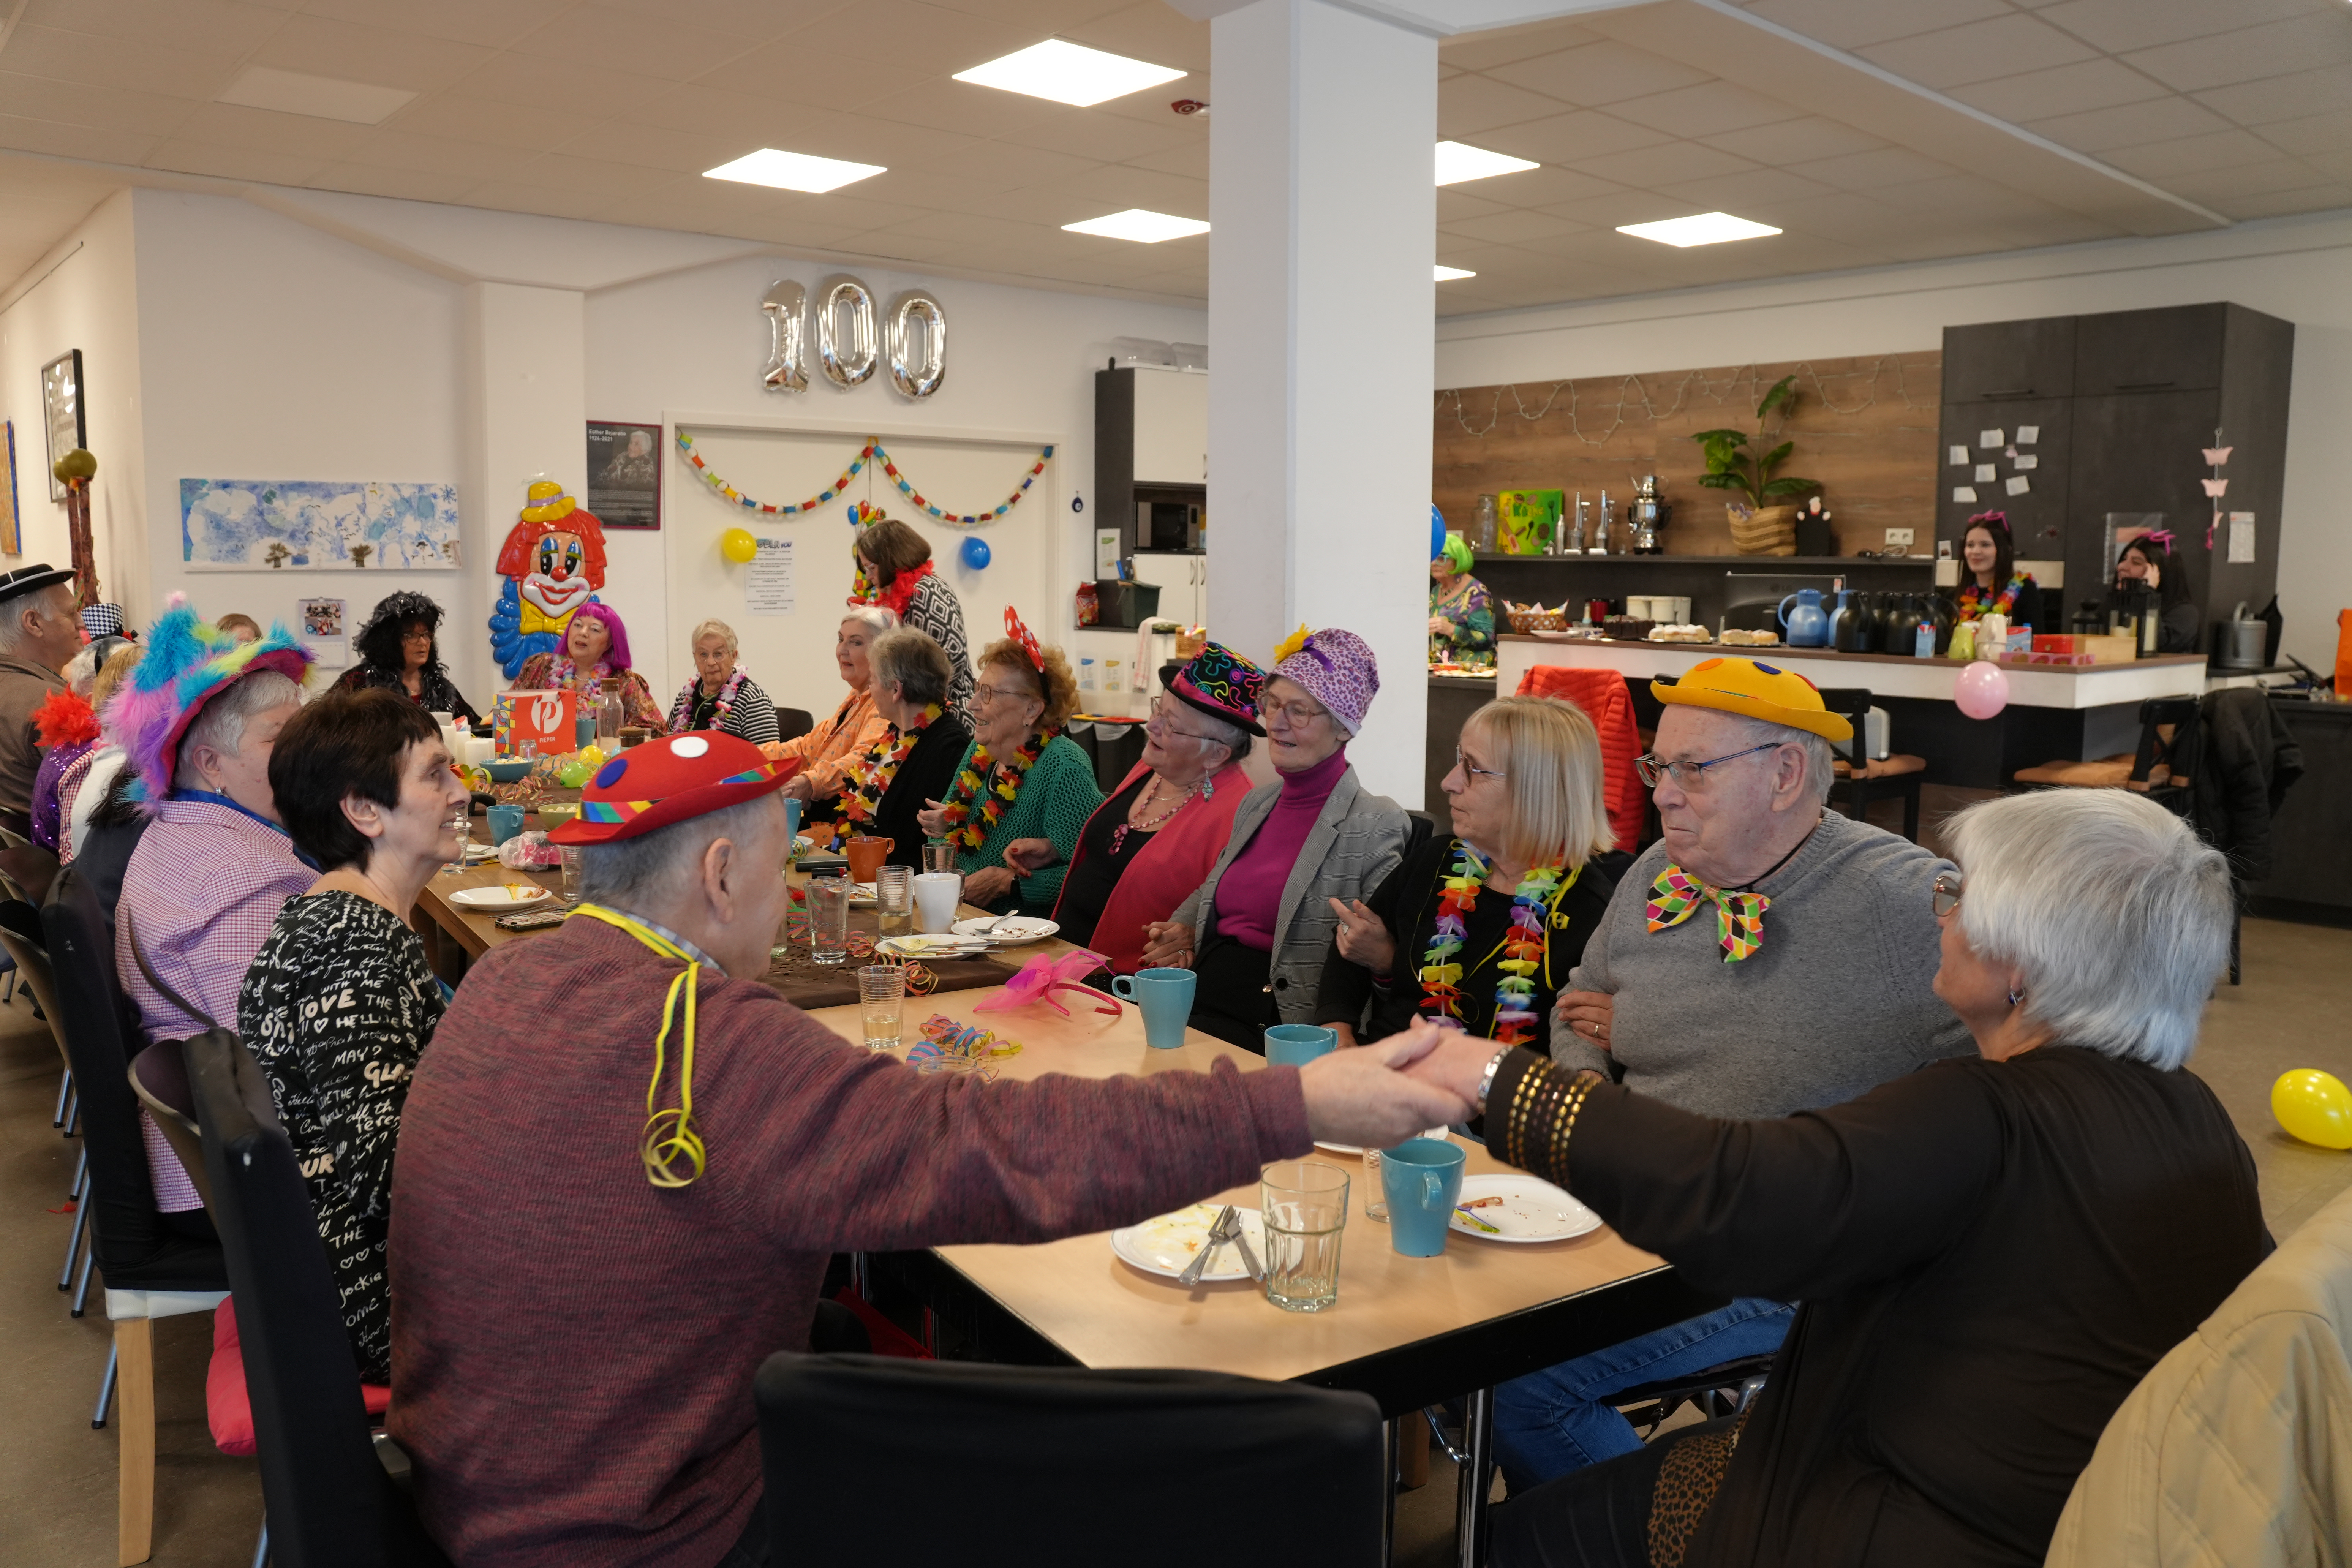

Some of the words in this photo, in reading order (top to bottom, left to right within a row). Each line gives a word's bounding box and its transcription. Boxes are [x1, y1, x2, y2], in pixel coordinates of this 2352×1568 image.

[760, 273, 947, 402] 100
[320, 980, 351, 994] WITH
[359, 979, 384, 988] ME
[335, 969, 370, 982] STAY
[298, 988, 357, 1024] LOVE
[365, 993, 394, 1011] THE
[299, 1152, 335, 1178] UR
[328, 1224, 367, 1249] THE
[342, 1297, 379, 1327] ome
